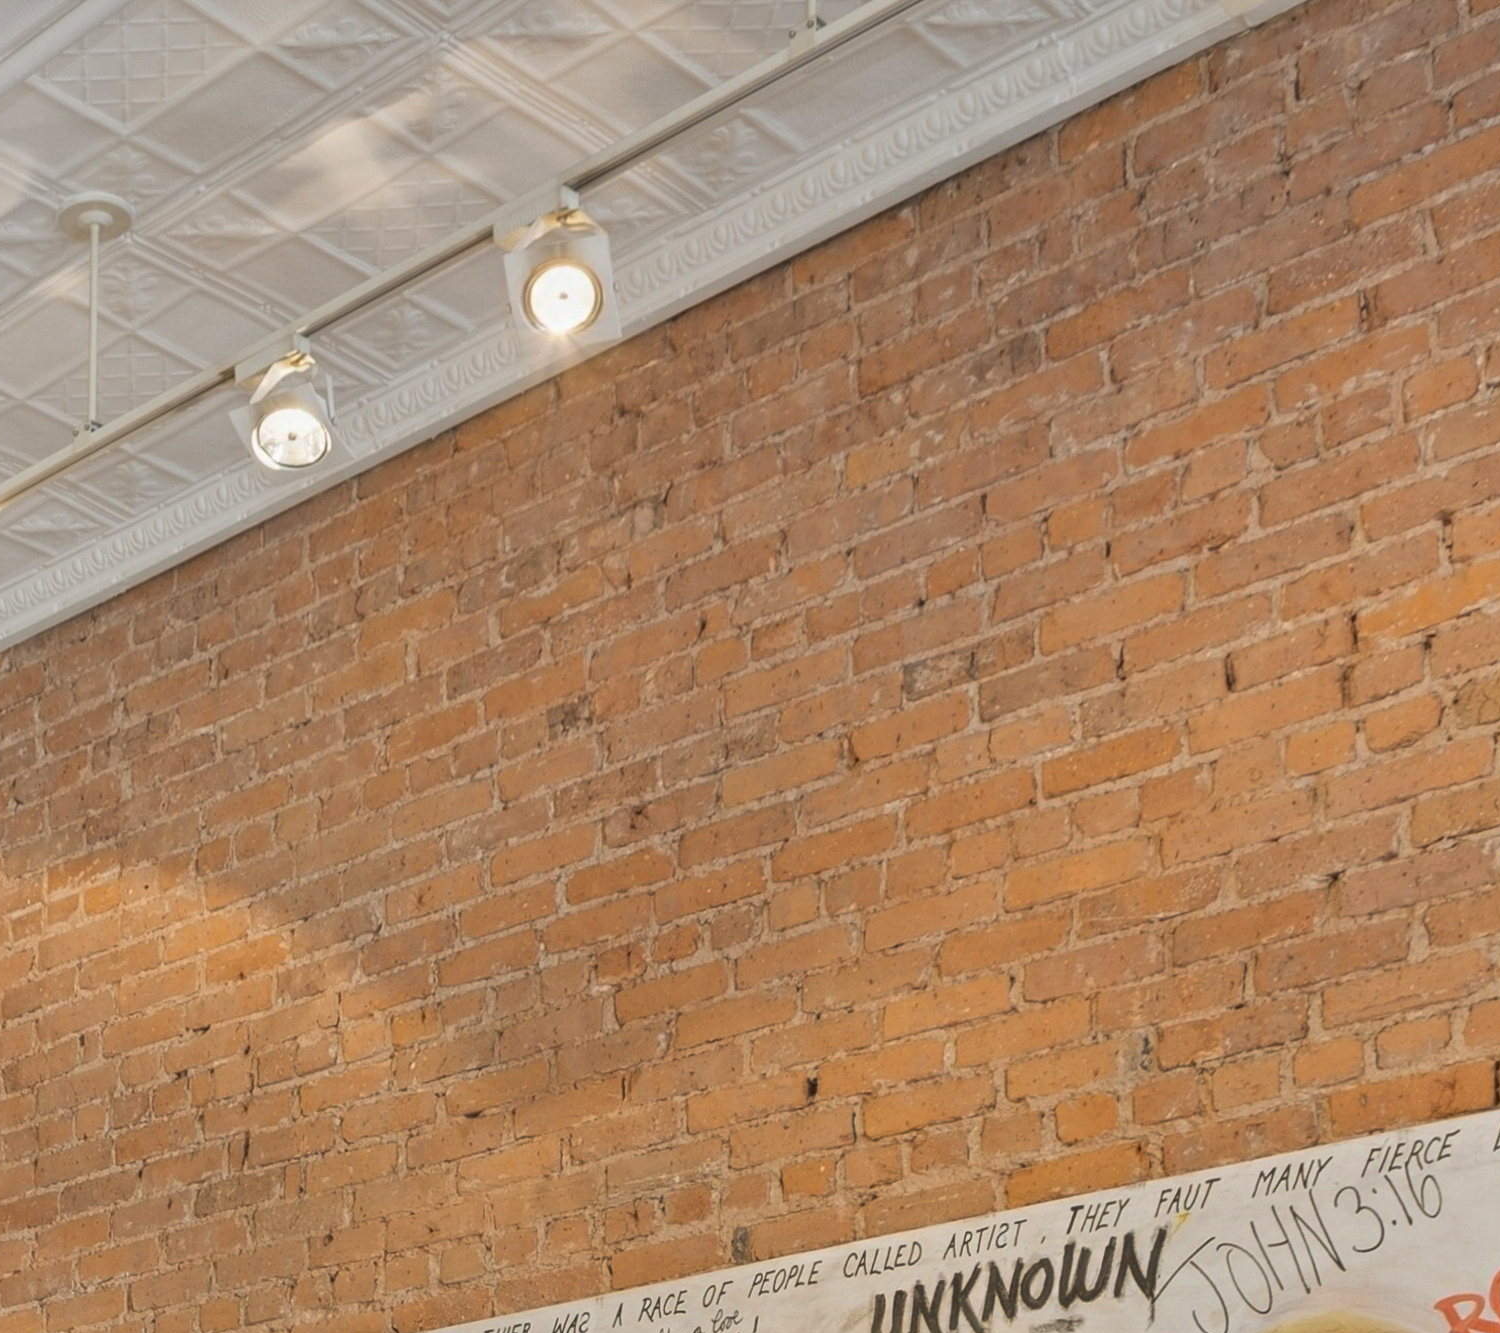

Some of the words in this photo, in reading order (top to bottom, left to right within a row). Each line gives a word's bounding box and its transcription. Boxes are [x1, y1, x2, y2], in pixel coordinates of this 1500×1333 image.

[612, 1303, 624, 1329] A
[638, 1290, 688, 1323] RACE
[702, 1280, 734, 1310] OF
[748, 1260, 823, 1299] PEOPLE
[843, 1236, 922, 1279] CALLED
[1066, 1198, 1131, 1235] THEY
[1154, 1178, 1221, 1219] FAUT
[1251, 1155, 1334, 1199] MANY
[1361, 1129, 1461, 1179] FIERCE
[1333, 1160, 1443, 1254] 3:16
[711, 1308, 744, 1333] love
